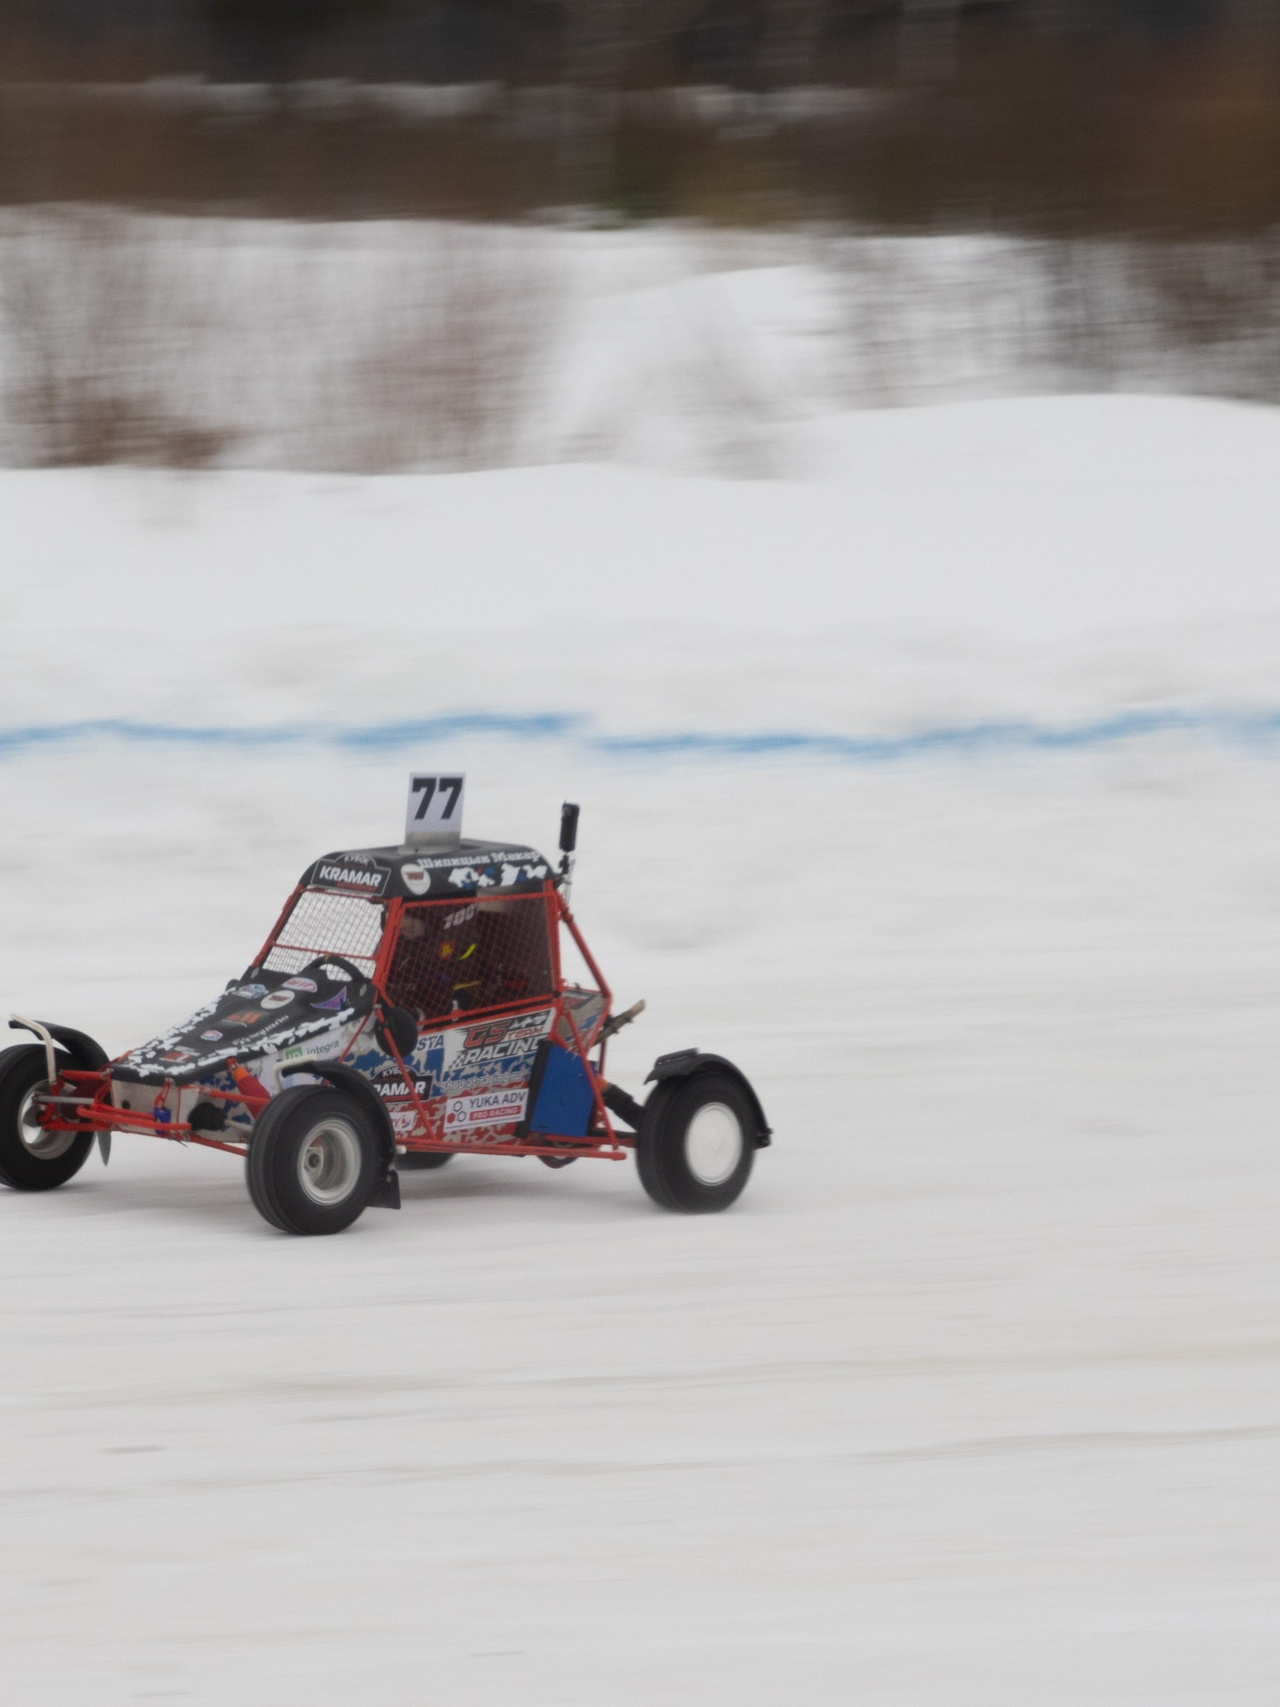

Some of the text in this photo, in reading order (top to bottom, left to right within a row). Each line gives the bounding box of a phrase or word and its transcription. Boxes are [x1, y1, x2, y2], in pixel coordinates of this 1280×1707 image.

[411, 777, 464, 820] 77
[319, 865, 382, 887] KRAMAR
[464, 1021, 509, 1048] GS
[470, 1091, 526, 1109] YUKA ADV
[490, 1107, 519, 1117] RACING
